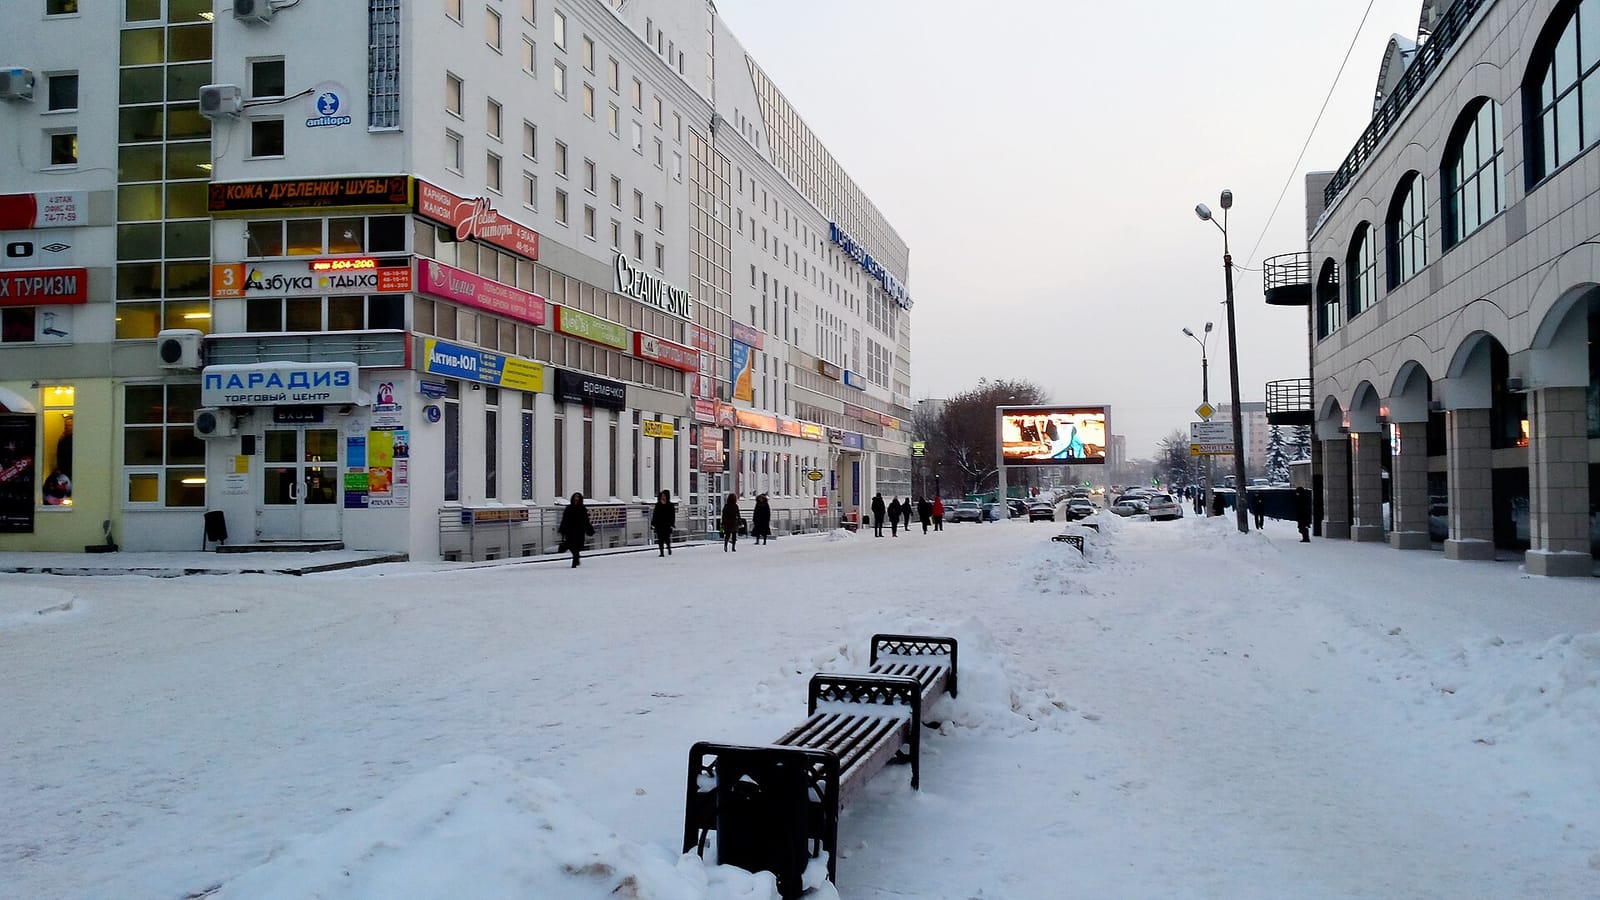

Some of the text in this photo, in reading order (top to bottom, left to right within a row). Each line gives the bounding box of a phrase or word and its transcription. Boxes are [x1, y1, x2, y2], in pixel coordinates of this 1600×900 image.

[306, 116, 351, 127] antilopa
[227, 180, 389, 200] КОЖА ДУБЛЕНКИ ШУБЫ
[15, 275, 77, 297] ТУРИЗМ
[223, 269, 235, 286] 3
[616, 252, 693, 319] CREATIVE STYLE
[428, 348, 476, 372] Актив-ЮЛ
[204, 370, 350, 390] ПАРАДИЗ
[583, 381, 625, 399] времечко
[224, 392, 330, 402] ТОРГОВЫЙ ЦЕНТР
